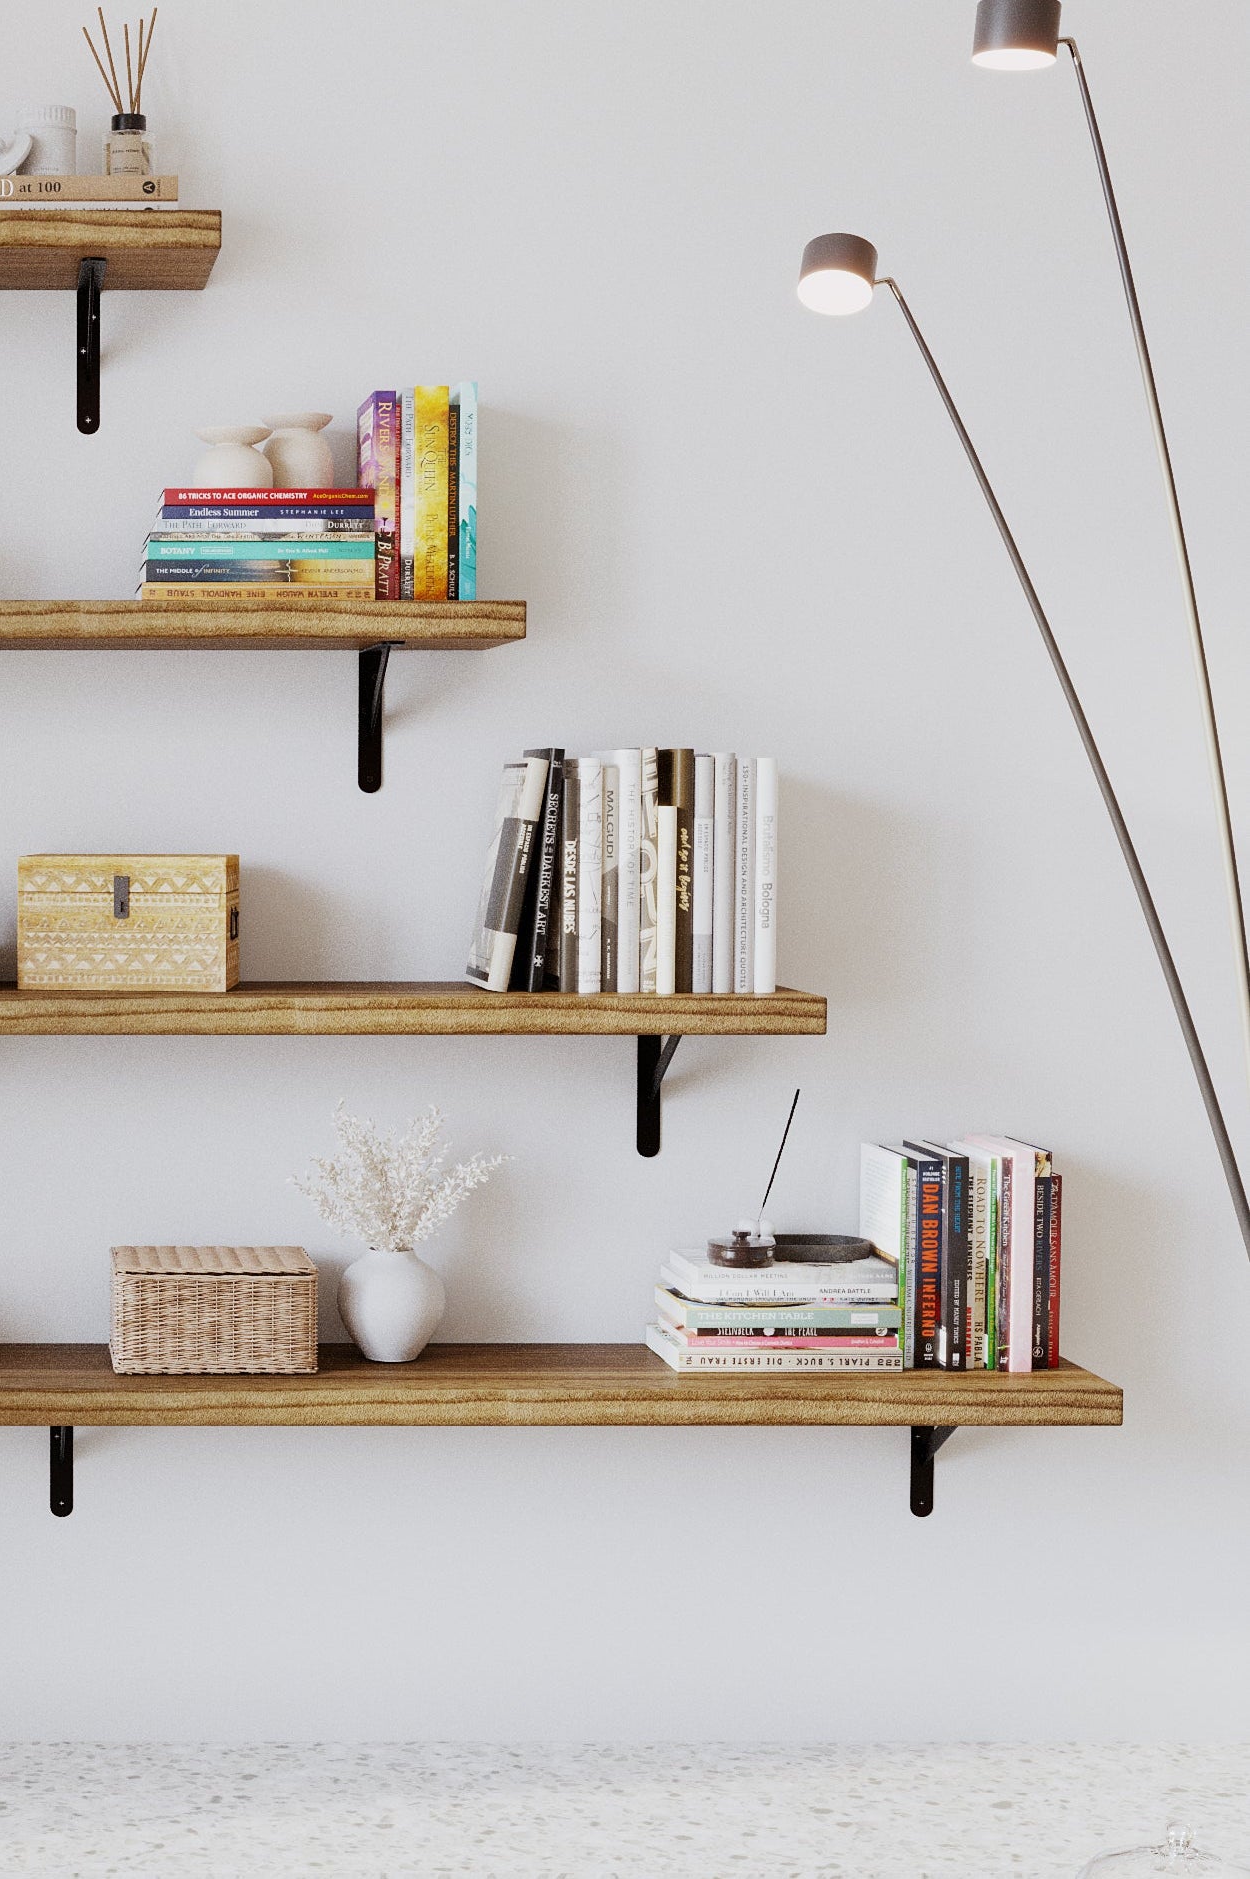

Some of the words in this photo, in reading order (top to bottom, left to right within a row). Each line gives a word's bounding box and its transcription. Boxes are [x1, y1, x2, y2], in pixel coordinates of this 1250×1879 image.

[19, 183, 32, 193] at
[37, 182, 61, 193] 100
[423, 425, 440, 453] SUN
[449, 412, 457, 449] DESTROY
[438, 449, 446, 464] THE
[449, 451, 457, 466] THIS
[421, 456, 438, 491] QUEEN
[188, 492, 211, 500] TRICKS
[449, 472, 457, 504] MARTIN
[189, 507, 222, 516] Endless
[223, 508, 260, 516] Summer
[449, 505, 457, 537] LUTHER
[425, 514, 438, 543] PETER
[378, 542, 391, 552] B.
[378, 554, 392, 596] PRATT
[404, 559, 413, 595] DURRETT
[425, 545, 437, 595] MEREDITH
[167, 589, 195, 597] STAUB
[202, 589, 242, 597] HANDVOLL
[246, 590, 266, 598] EINE
[627, 783, 635, 807] THE
[544, 793, 559, 844] SECRETS
[606, 790, 614, 859] MALGUDI
[627, 810, 635, 858] HISTORY
[761, 815, 774, 876] Brutalismo
[627, 862, 635, 874] OF
[539, 855, 552, 910] DARKEST
[564, 877, 575, 898] LAS
[626, 881, 635, 908] TIME
[759, 883, 773, 929] Bologna
[536, 911, 548, 935] ART
[975, 1178, 987, 1212] ROAD
[1002, 1174, 1011, 1191] The
[922, 1184, 939, 1213] DAN
[1002, 1191, 1010, 1217] Green
[1036, 1185, 1044, 1216] BESIDE
[976, 1218, 987, 1234] TO
[1002, 1217, 1010, 1246] Kitchen
[1036, 1218, 1044, 1238] TWO
[921, 1220, 939, 1272] BROWN
[974, 1240, 987, 1303] NOWHERE
[921, 1278, 936, 1337] INFERNO
[974, 1322, 983, 1334] HS
[974, 1336, 983, 1362] PABLA
